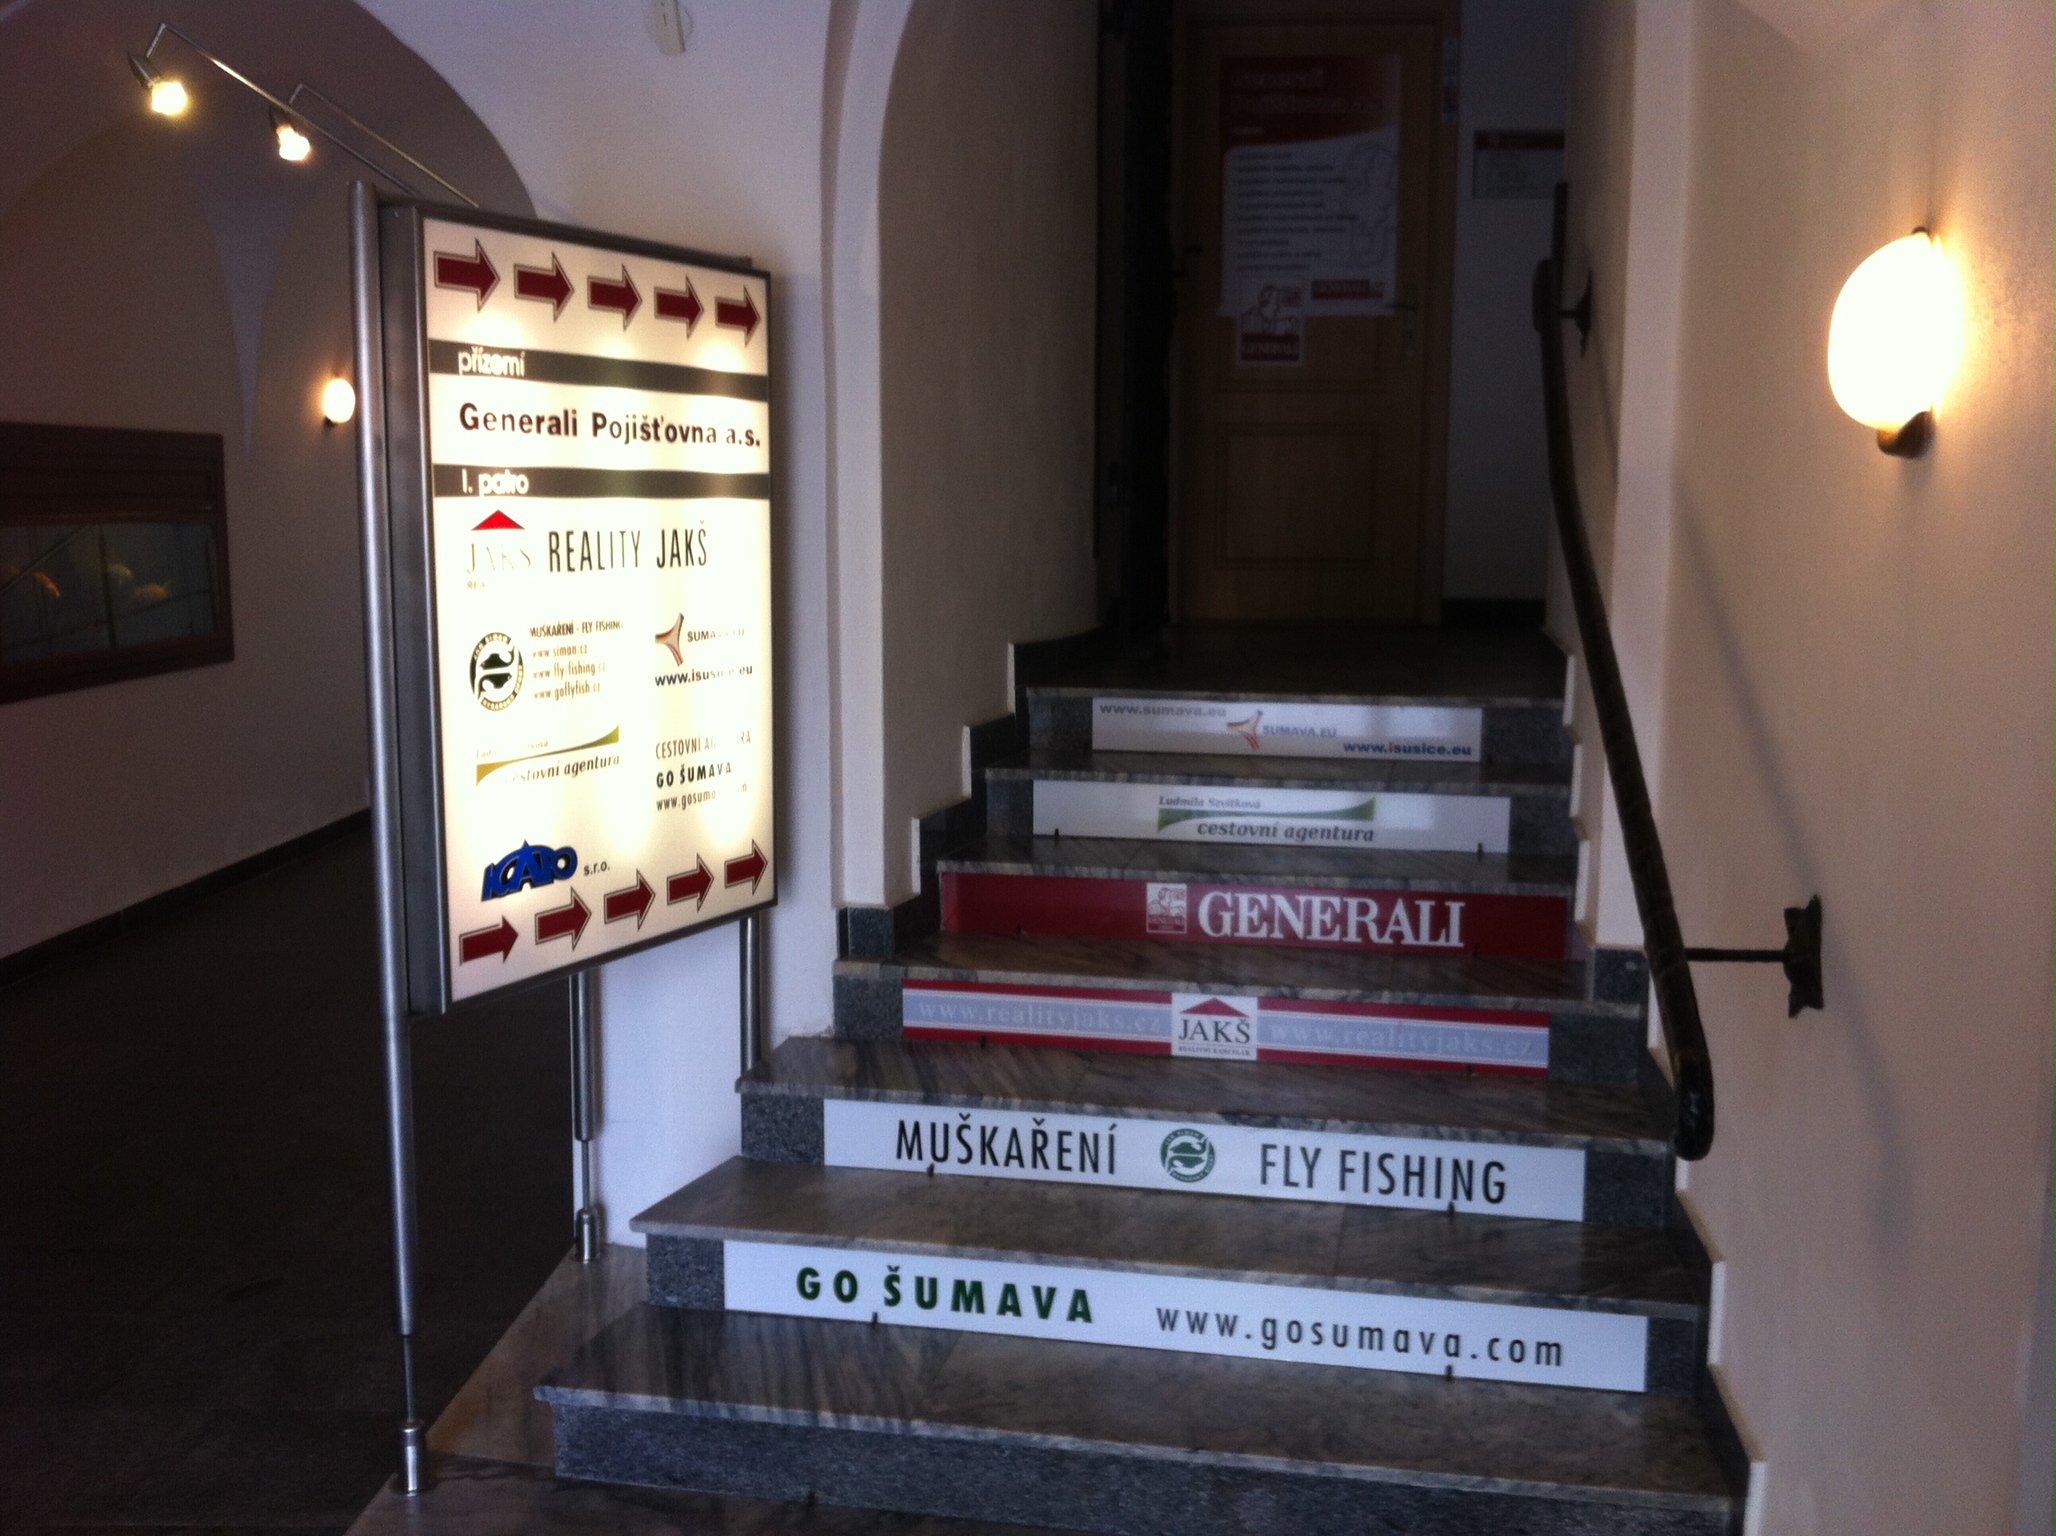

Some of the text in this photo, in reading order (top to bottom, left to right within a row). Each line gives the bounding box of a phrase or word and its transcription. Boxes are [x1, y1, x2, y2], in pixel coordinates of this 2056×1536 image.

[459, 402, 761, 447] Generali Pojišťovna a.s.
[479, 470, 529, 497] patro
[548, 519, 707, 573] REALITY JAKŠ
[1099, 702, 1227, 719] www.sumava.eu
[655, 733, 702, 760] CESTOVNÍ
[1343, 740, 1472, 757] www.isusice.eu
[564, 755, 620, 778] agentura
[656, 761, 731, 789] GO ŠUMAVA
[1197, 818, 1375, 844] cestovní agentura
[583, 860, 611, 877] s.r.o.
[1200, 890, 1465, 948] GENERALI
[918, 1001, 1161, 1032] www.realityjaks.cz
[1178, 1017, 1251, 1044] JAKŠ
[1269, 1017, 1535, 1057] www.realityjaks.cz
[895, 1113, 1118, 1176] MUŠKAŘENÍ
[1260, 1143, 1507, 1206] FLY FISHING
[797, 1265, 1093, 1324] GO ŠUMAVA
[1155, 1304, 1564, 1368] www.gosumava.com
